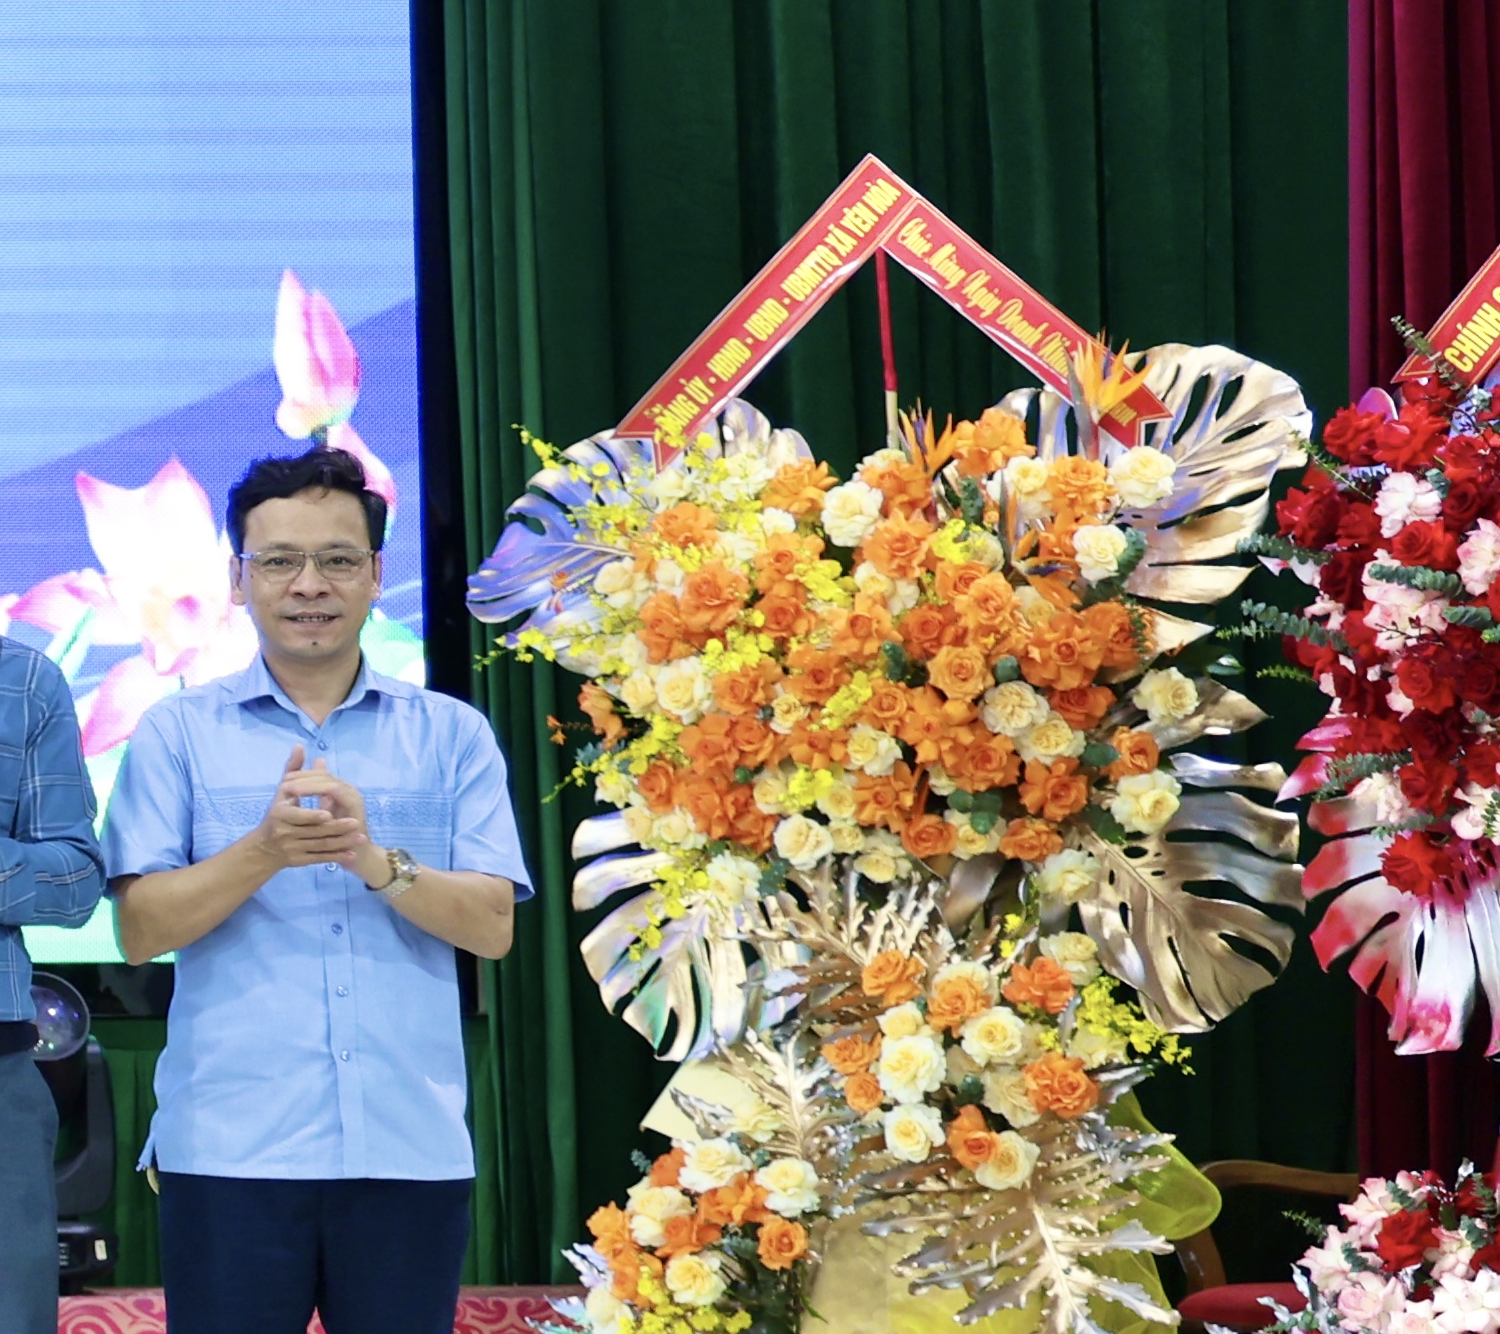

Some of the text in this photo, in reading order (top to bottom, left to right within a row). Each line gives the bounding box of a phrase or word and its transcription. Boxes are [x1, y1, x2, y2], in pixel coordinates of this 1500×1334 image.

[742, 297, 790, 342] UBND
[780, 243, 843, 302] UBMTTQ
[1444, 301, 1500, 373] CHÍNH
